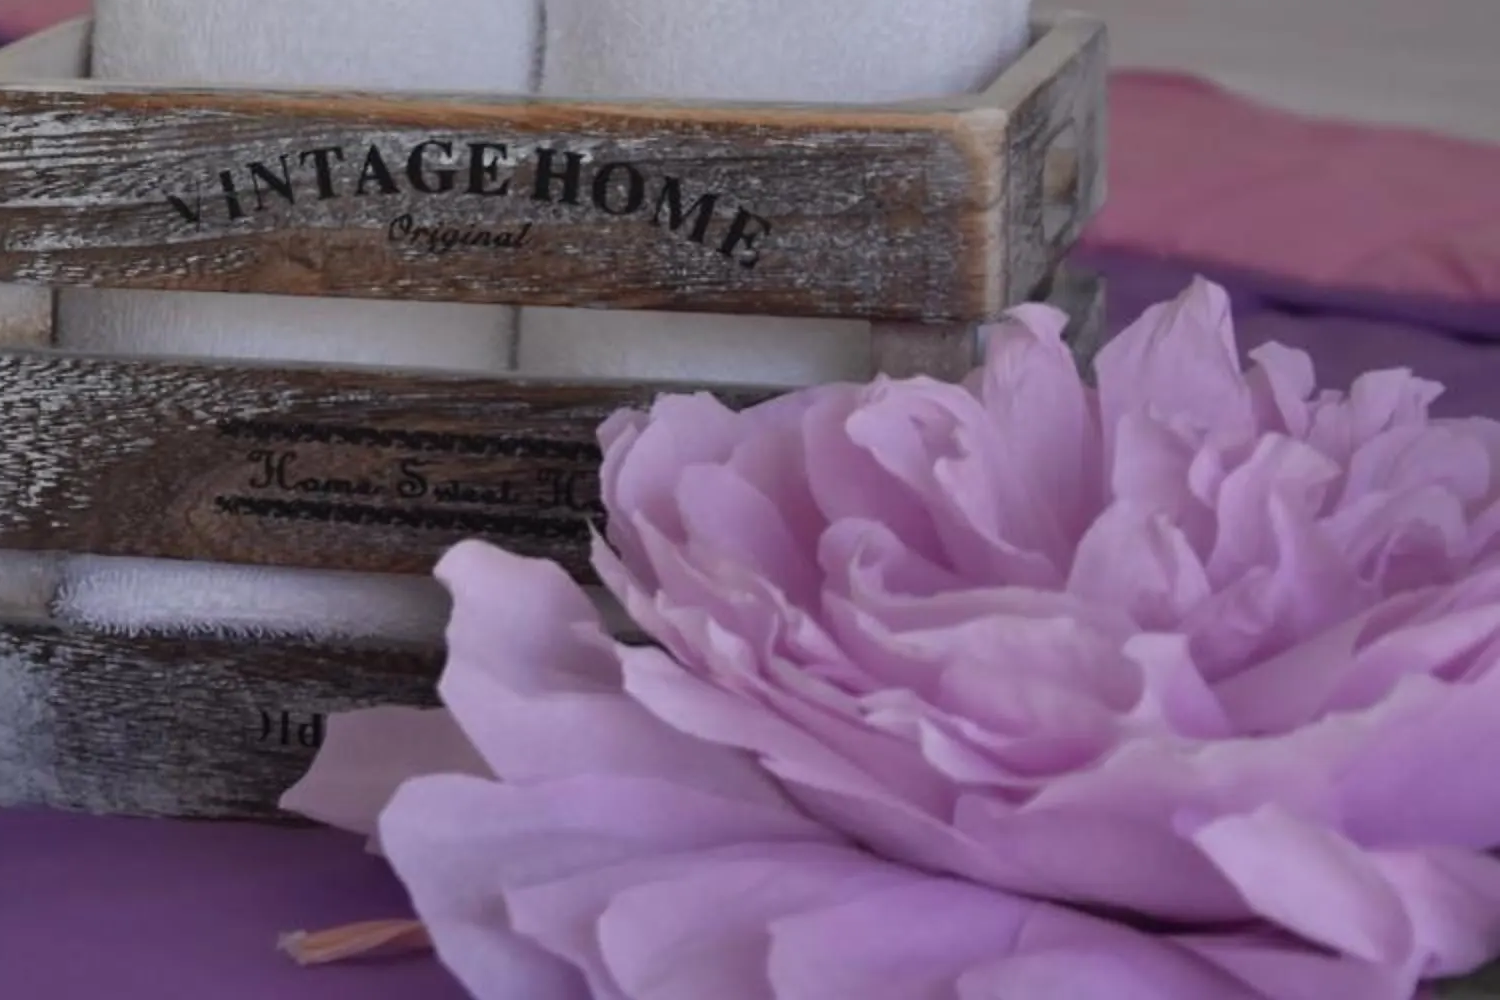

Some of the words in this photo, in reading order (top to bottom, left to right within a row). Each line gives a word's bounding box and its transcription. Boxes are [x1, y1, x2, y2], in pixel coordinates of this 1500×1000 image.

[167, 140, 509, 223] VINTAGE
[533, 146, 772, 268] HOME
[388, 213, 532, 251] Original
